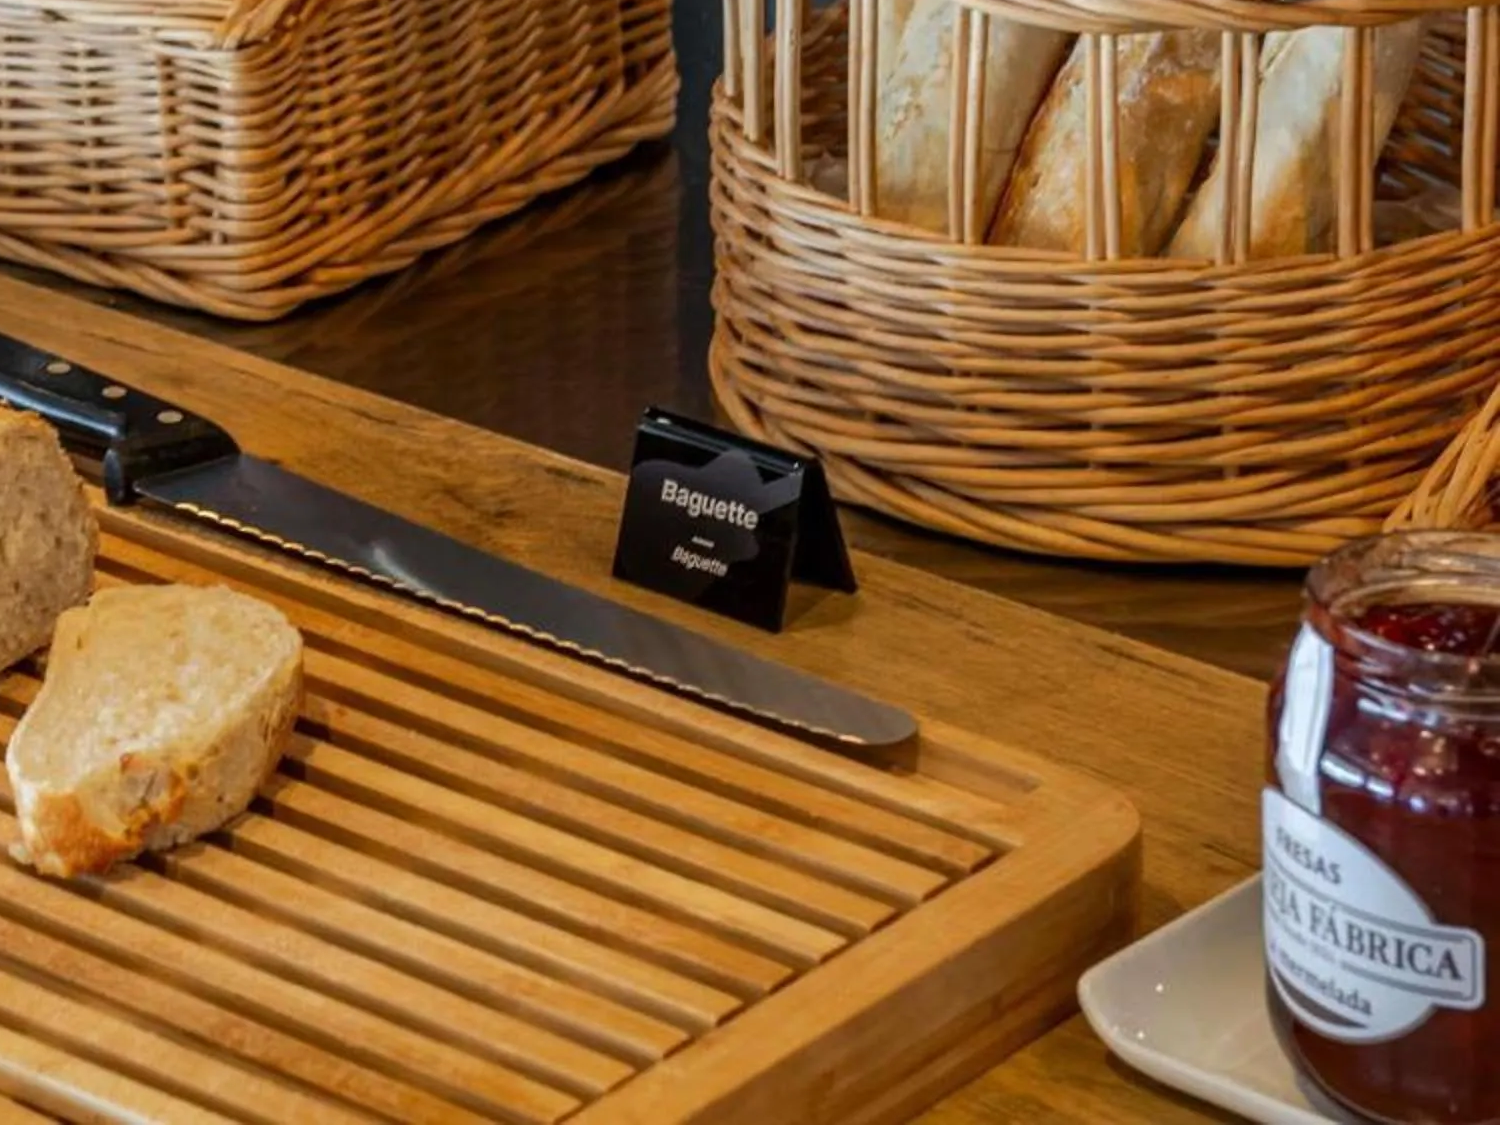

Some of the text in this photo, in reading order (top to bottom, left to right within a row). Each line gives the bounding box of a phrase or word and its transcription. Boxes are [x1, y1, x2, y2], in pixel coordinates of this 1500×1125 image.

[661, 478, 759, 529] Baguette
[669, 546, 729, 578] Baguette
[1308, 901, 1463, 981] FÁBRICA
